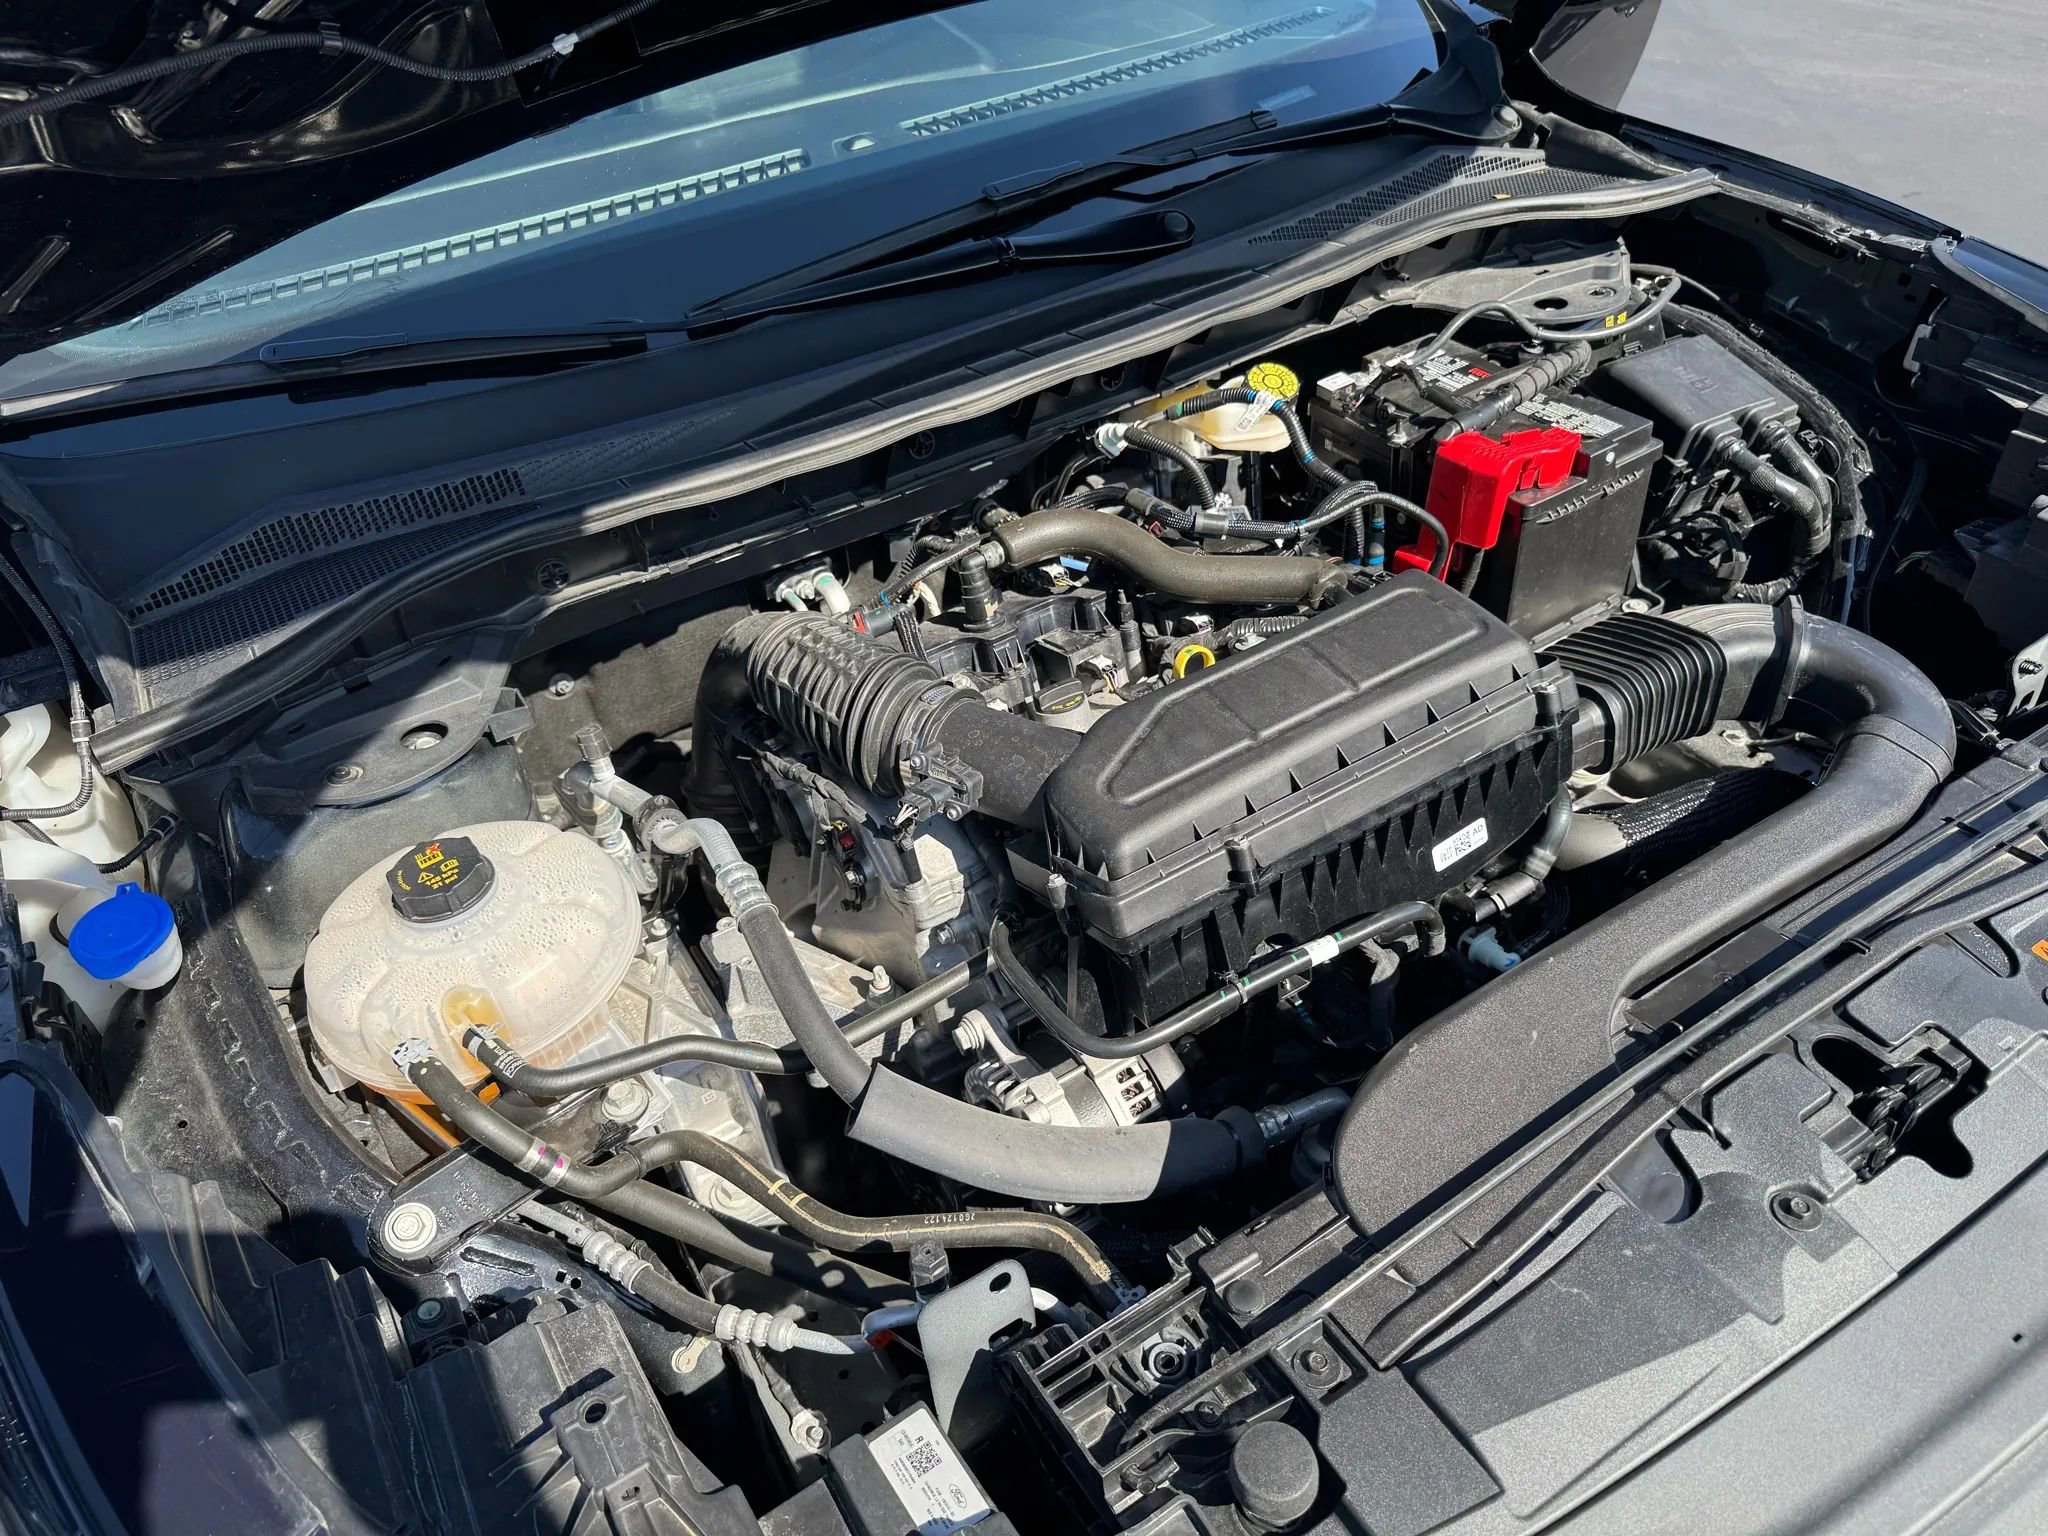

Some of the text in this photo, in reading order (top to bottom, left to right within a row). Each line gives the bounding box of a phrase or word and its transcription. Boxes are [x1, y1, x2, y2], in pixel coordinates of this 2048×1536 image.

[441, 868, 459, 879] kPa
[431, 874, 458, 890] 21 psi
[924, 1215, 940, 1224] 122
[914, 1435, 925, 1444] R
[949, 1485, 966, 1507] Ford
